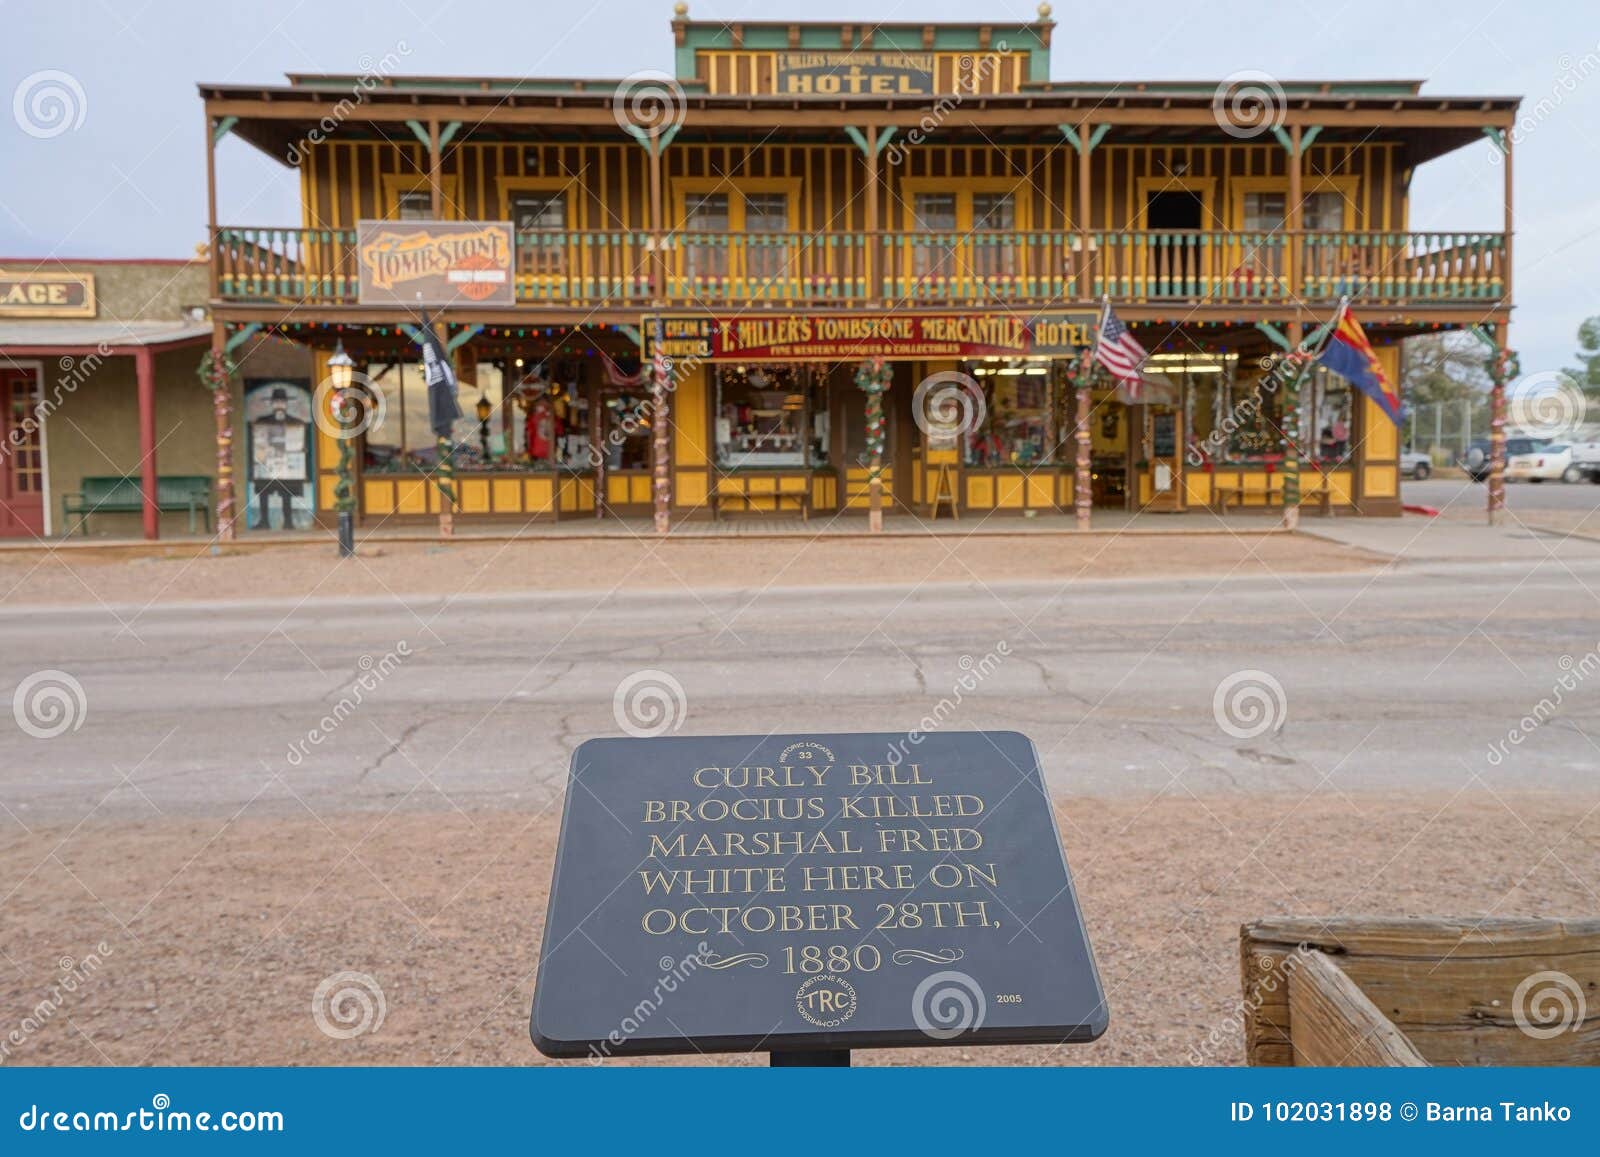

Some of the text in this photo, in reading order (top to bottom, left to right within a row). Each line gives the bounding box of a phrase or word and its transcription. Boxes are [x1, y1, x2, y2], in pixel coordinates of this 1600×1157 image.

[787, 75, 923, 94] HOTEL
[719, 317, 1025, 352] T. MILLER'S TOMBSTONE MERCANTILE
[1035, 322, 1091, 346] HOTEL
[779, 742, 836, 763] HISTORIC LOCATION
[799, 751, 813, 760] 33
[693, 763, 933, 788] CURLY BILL
[641, 794, 984, 823] BROCIUS KILLED
[647, 828, 983, 857] MARSHAL FRED
[638, 862, 1000, 895] WHITE HERE ON
[641, 901, 1001, 935] OCTOBER 28TH,
[780, 944, 881, 974] 1880
[796, 974, 858, 1028] TOMBSTONE RESTORATION COMMISSION
[803, 989, 850, 1012] TRC
[996, 994, 1023, 1004] 2005
